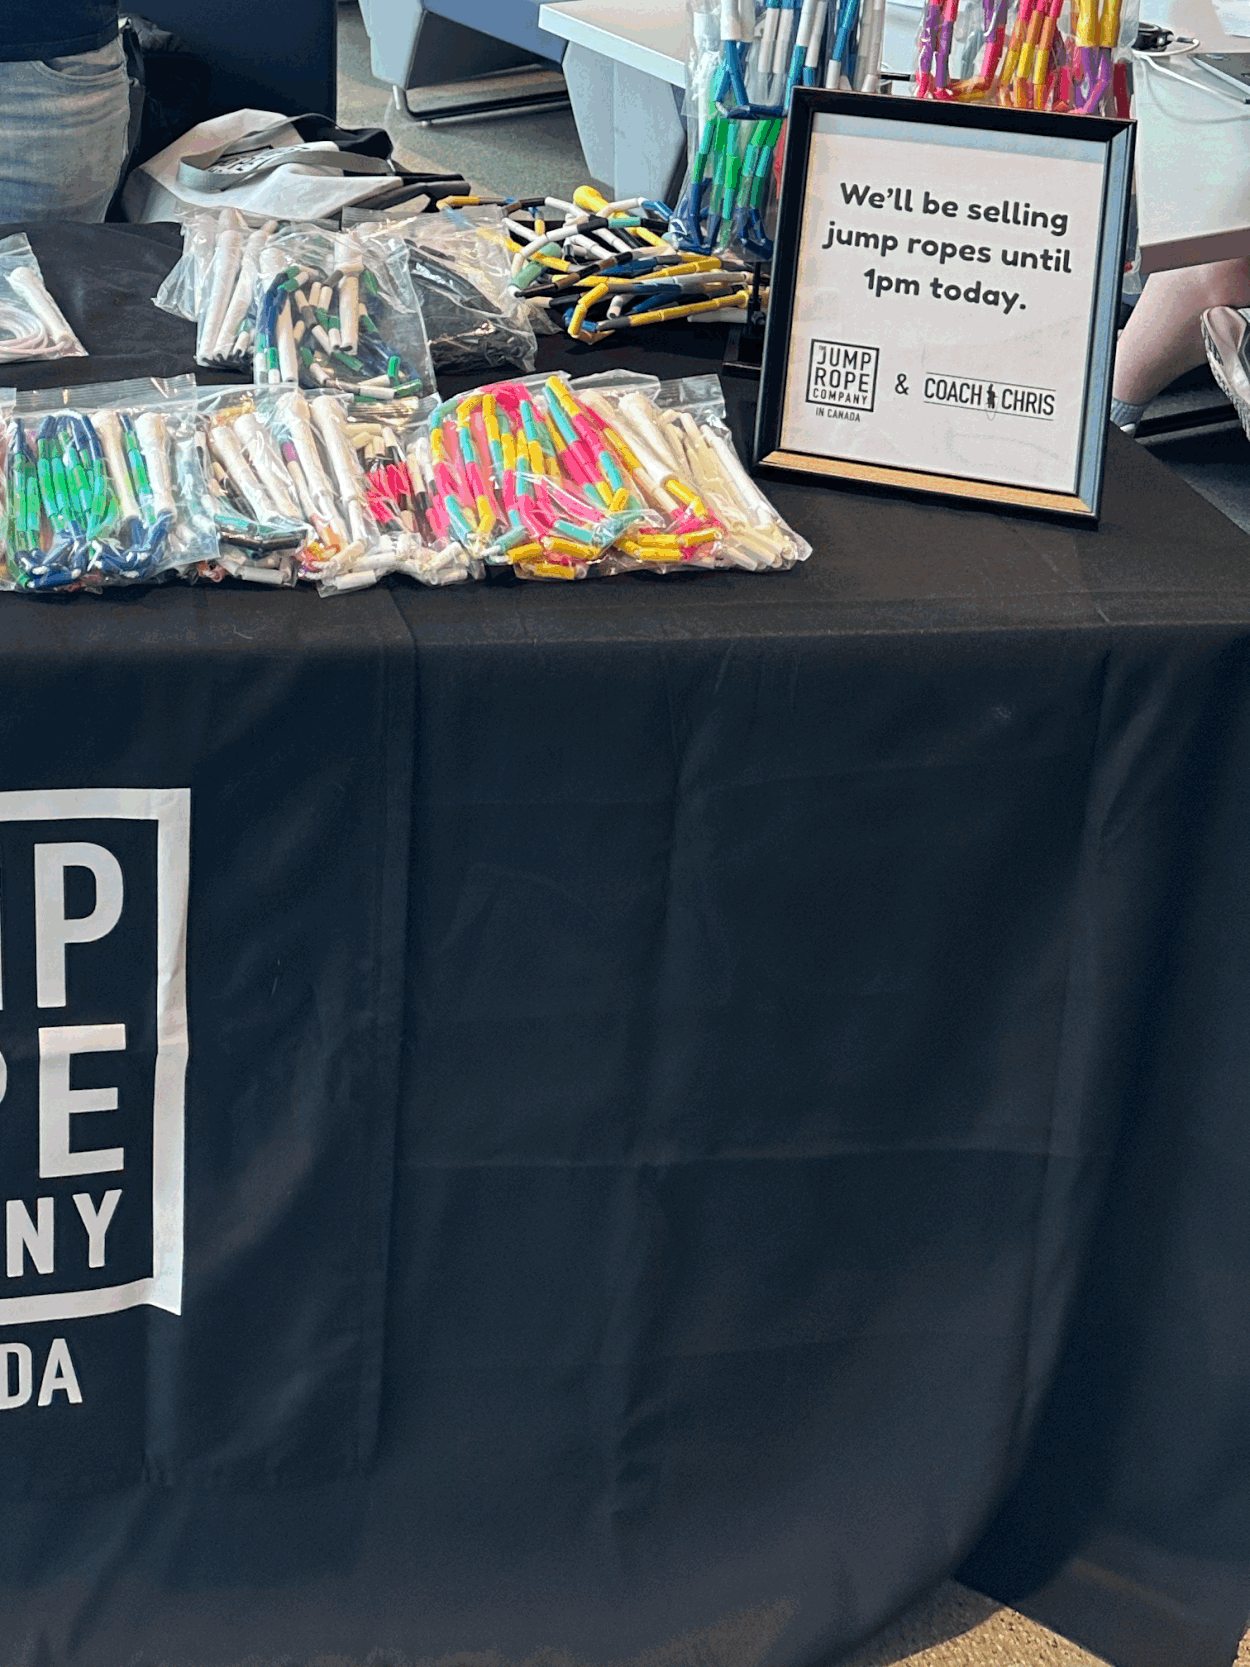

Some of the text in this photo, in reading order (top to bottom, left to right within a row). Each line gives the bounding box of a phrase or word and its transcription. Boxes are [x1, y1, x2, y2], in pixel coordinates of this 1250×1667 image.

[839, 182, 1069, 237] We'll be selling
[822, 221, 1072, 274] jump ropes until
[862, 268, 1027, 315] 1pm today.
[816, 346, 872, 372] JUMP
[814, 367, 870, 393] ROPE
[894, 373, 910, 396] &
[812, 388, 868, 406] COMPANY
[923, 377, 1055, 416] COACH CHRIS
[815, 407, 861, 423] IN CANADA
